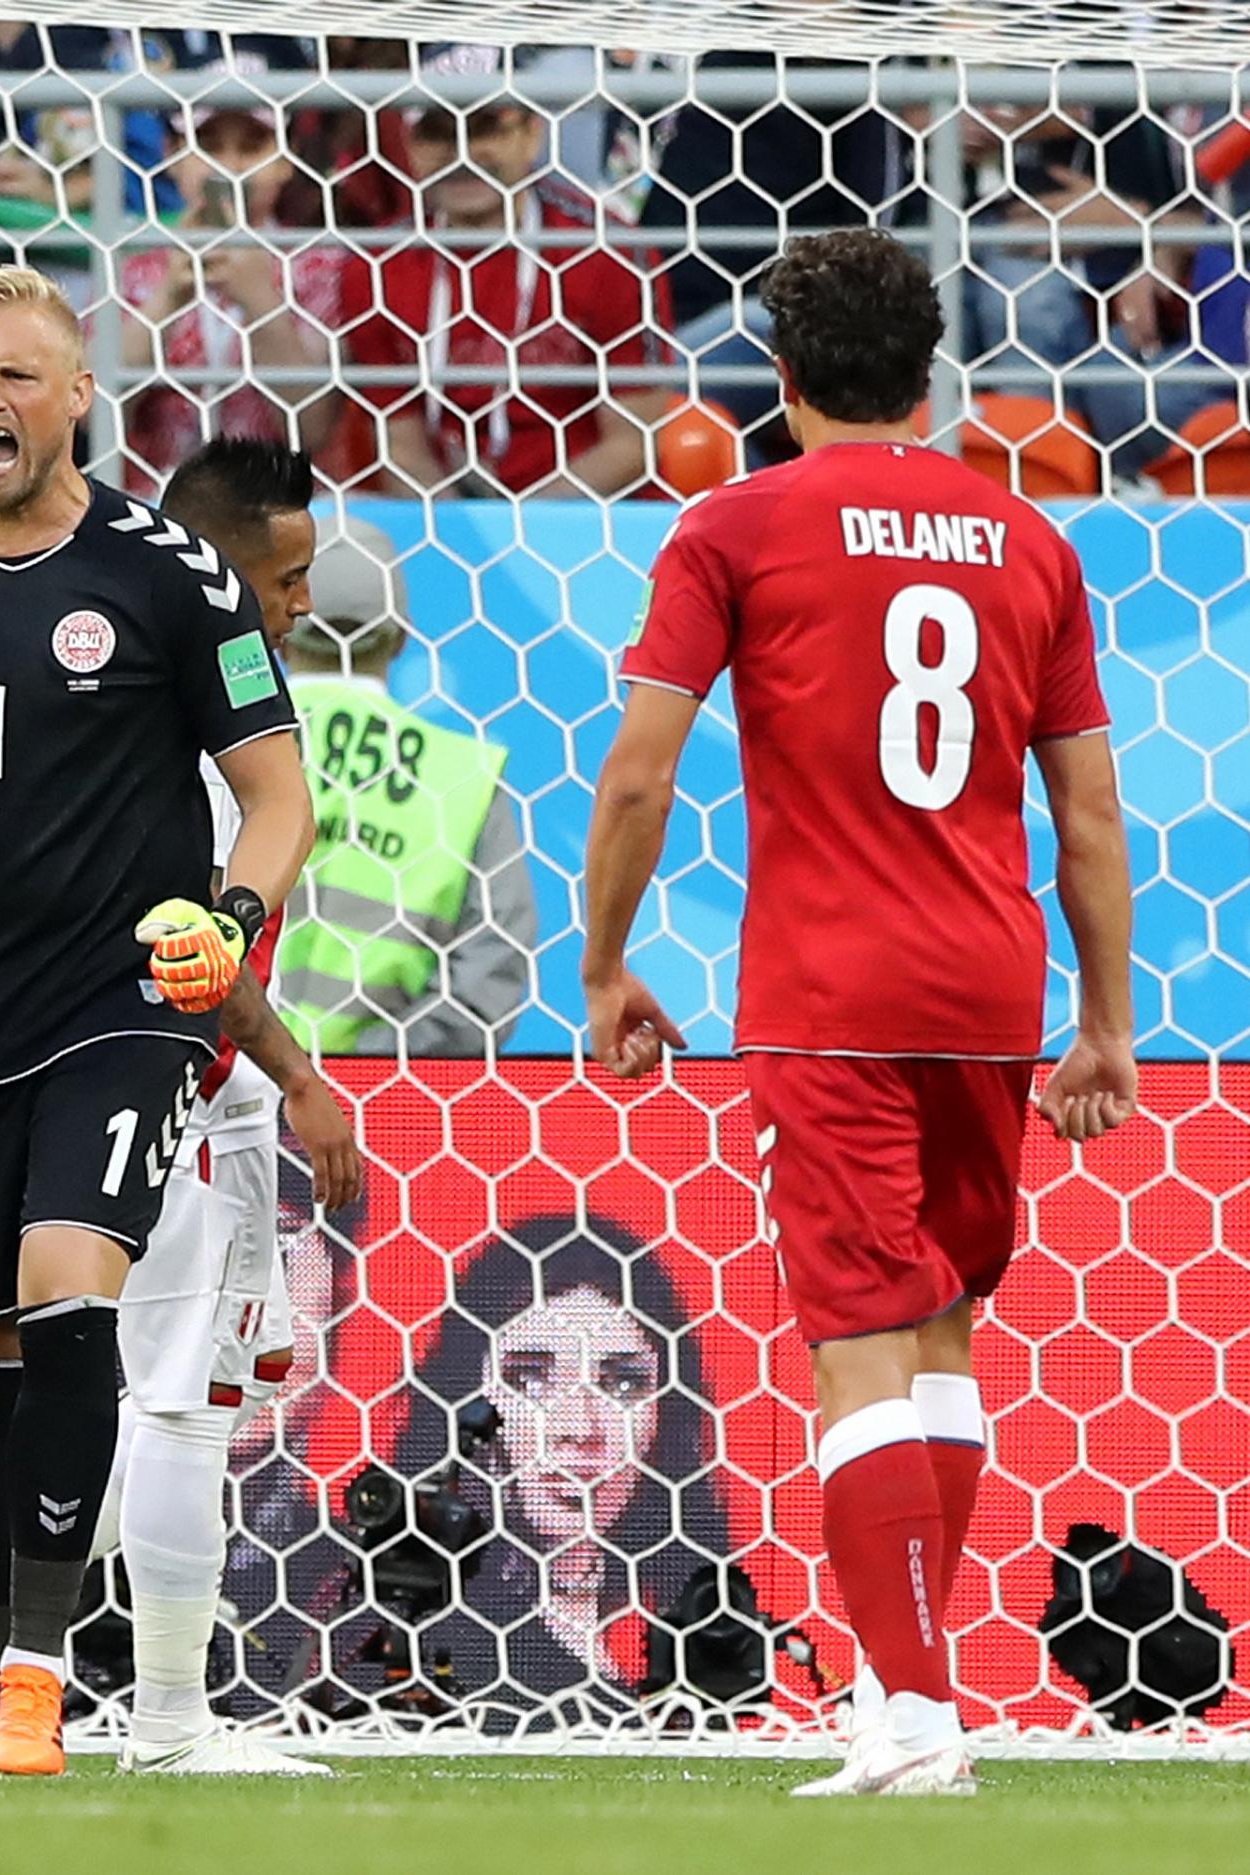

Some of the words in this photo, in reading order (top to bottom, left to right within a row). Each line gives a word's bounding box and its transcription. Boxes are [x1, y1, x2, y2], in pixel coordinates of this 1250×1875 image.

[840, 507, 1006, 567] DELANEY
[879, 583, 979, 811] 8
[101, 1108, 139, 1197] 1
[907, 1539, 935, 1649] DANMARK
